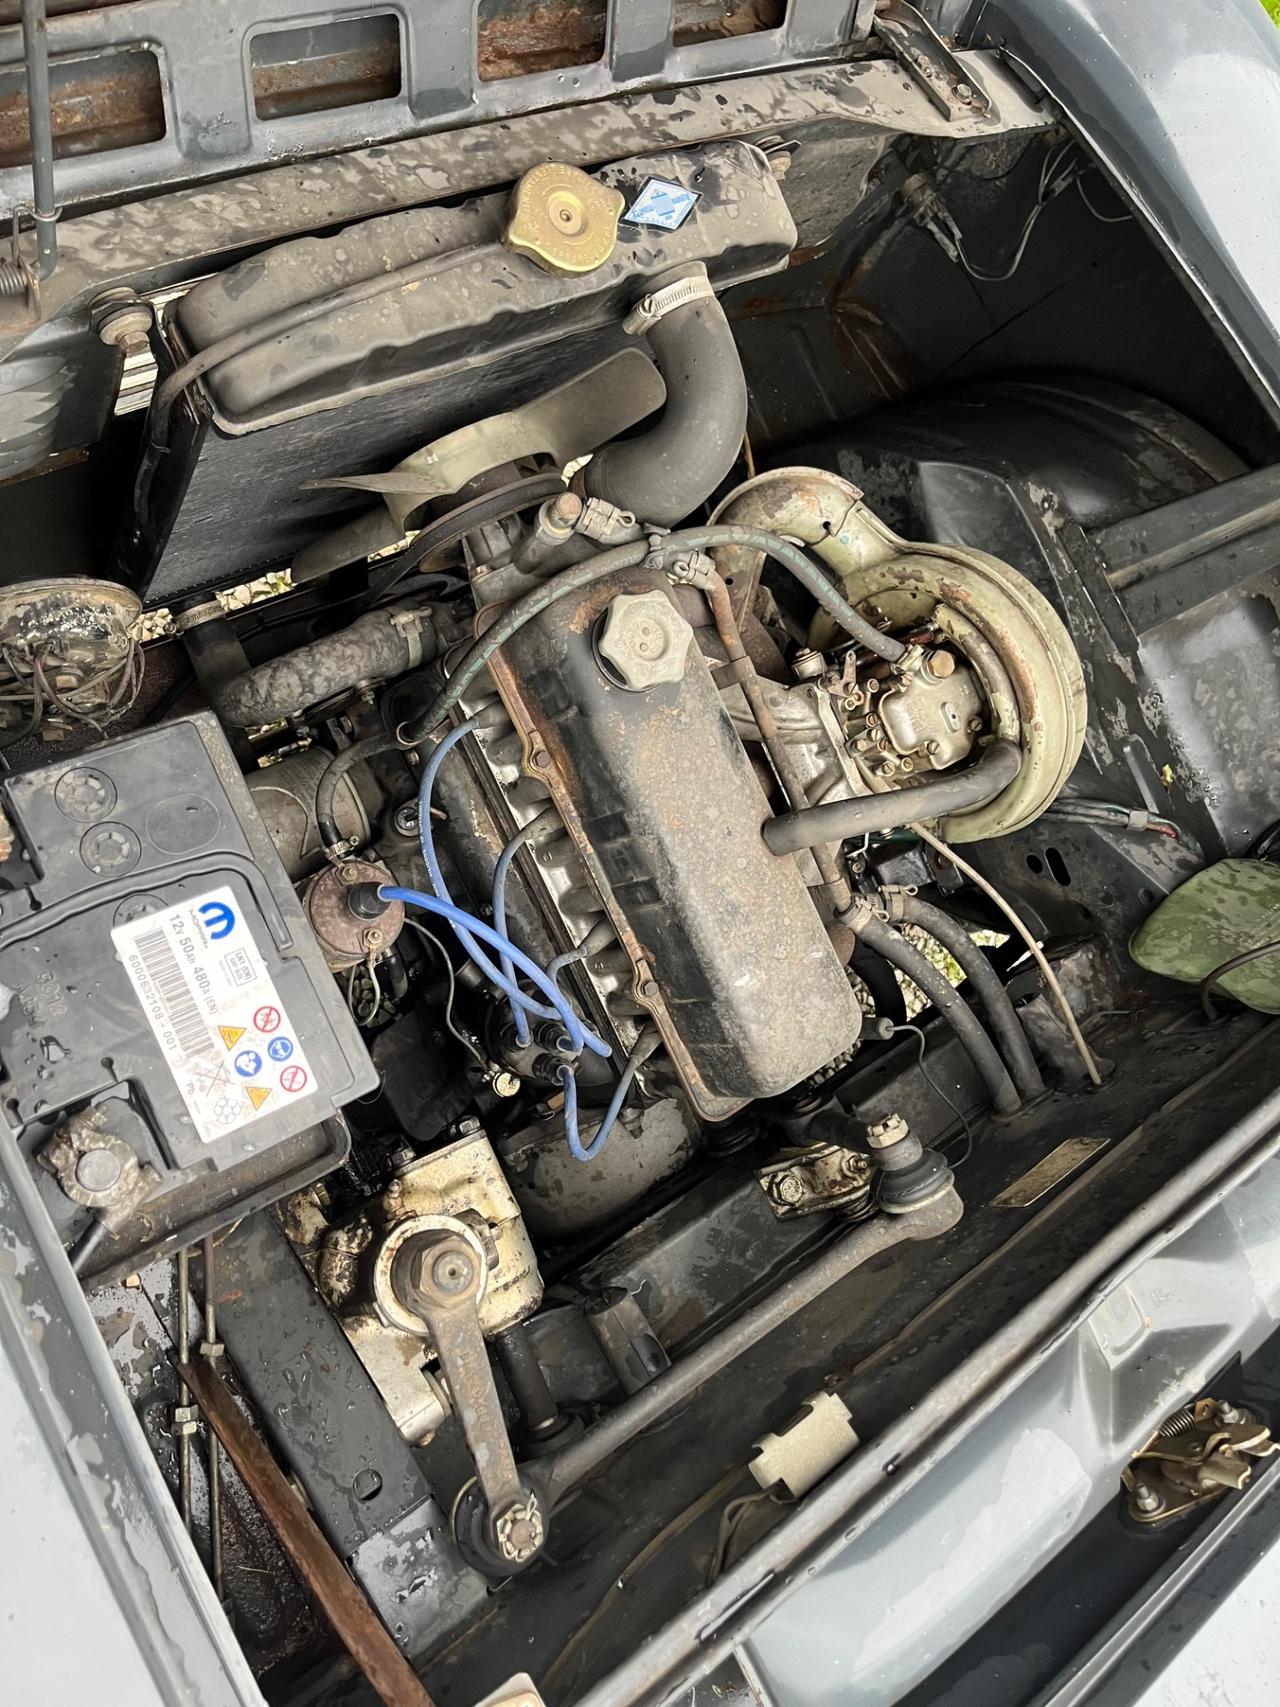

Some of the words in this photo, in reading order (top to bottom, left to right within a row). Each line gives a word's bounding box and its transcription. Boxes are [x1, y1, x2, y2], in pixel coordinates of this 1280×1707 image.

[179, 937, 197, 964] 50Ah
[193, 966, 212, 995] 480A
[204, 995, 219, 1015] (EN)
[163, 1031, 177, 1050] 001
